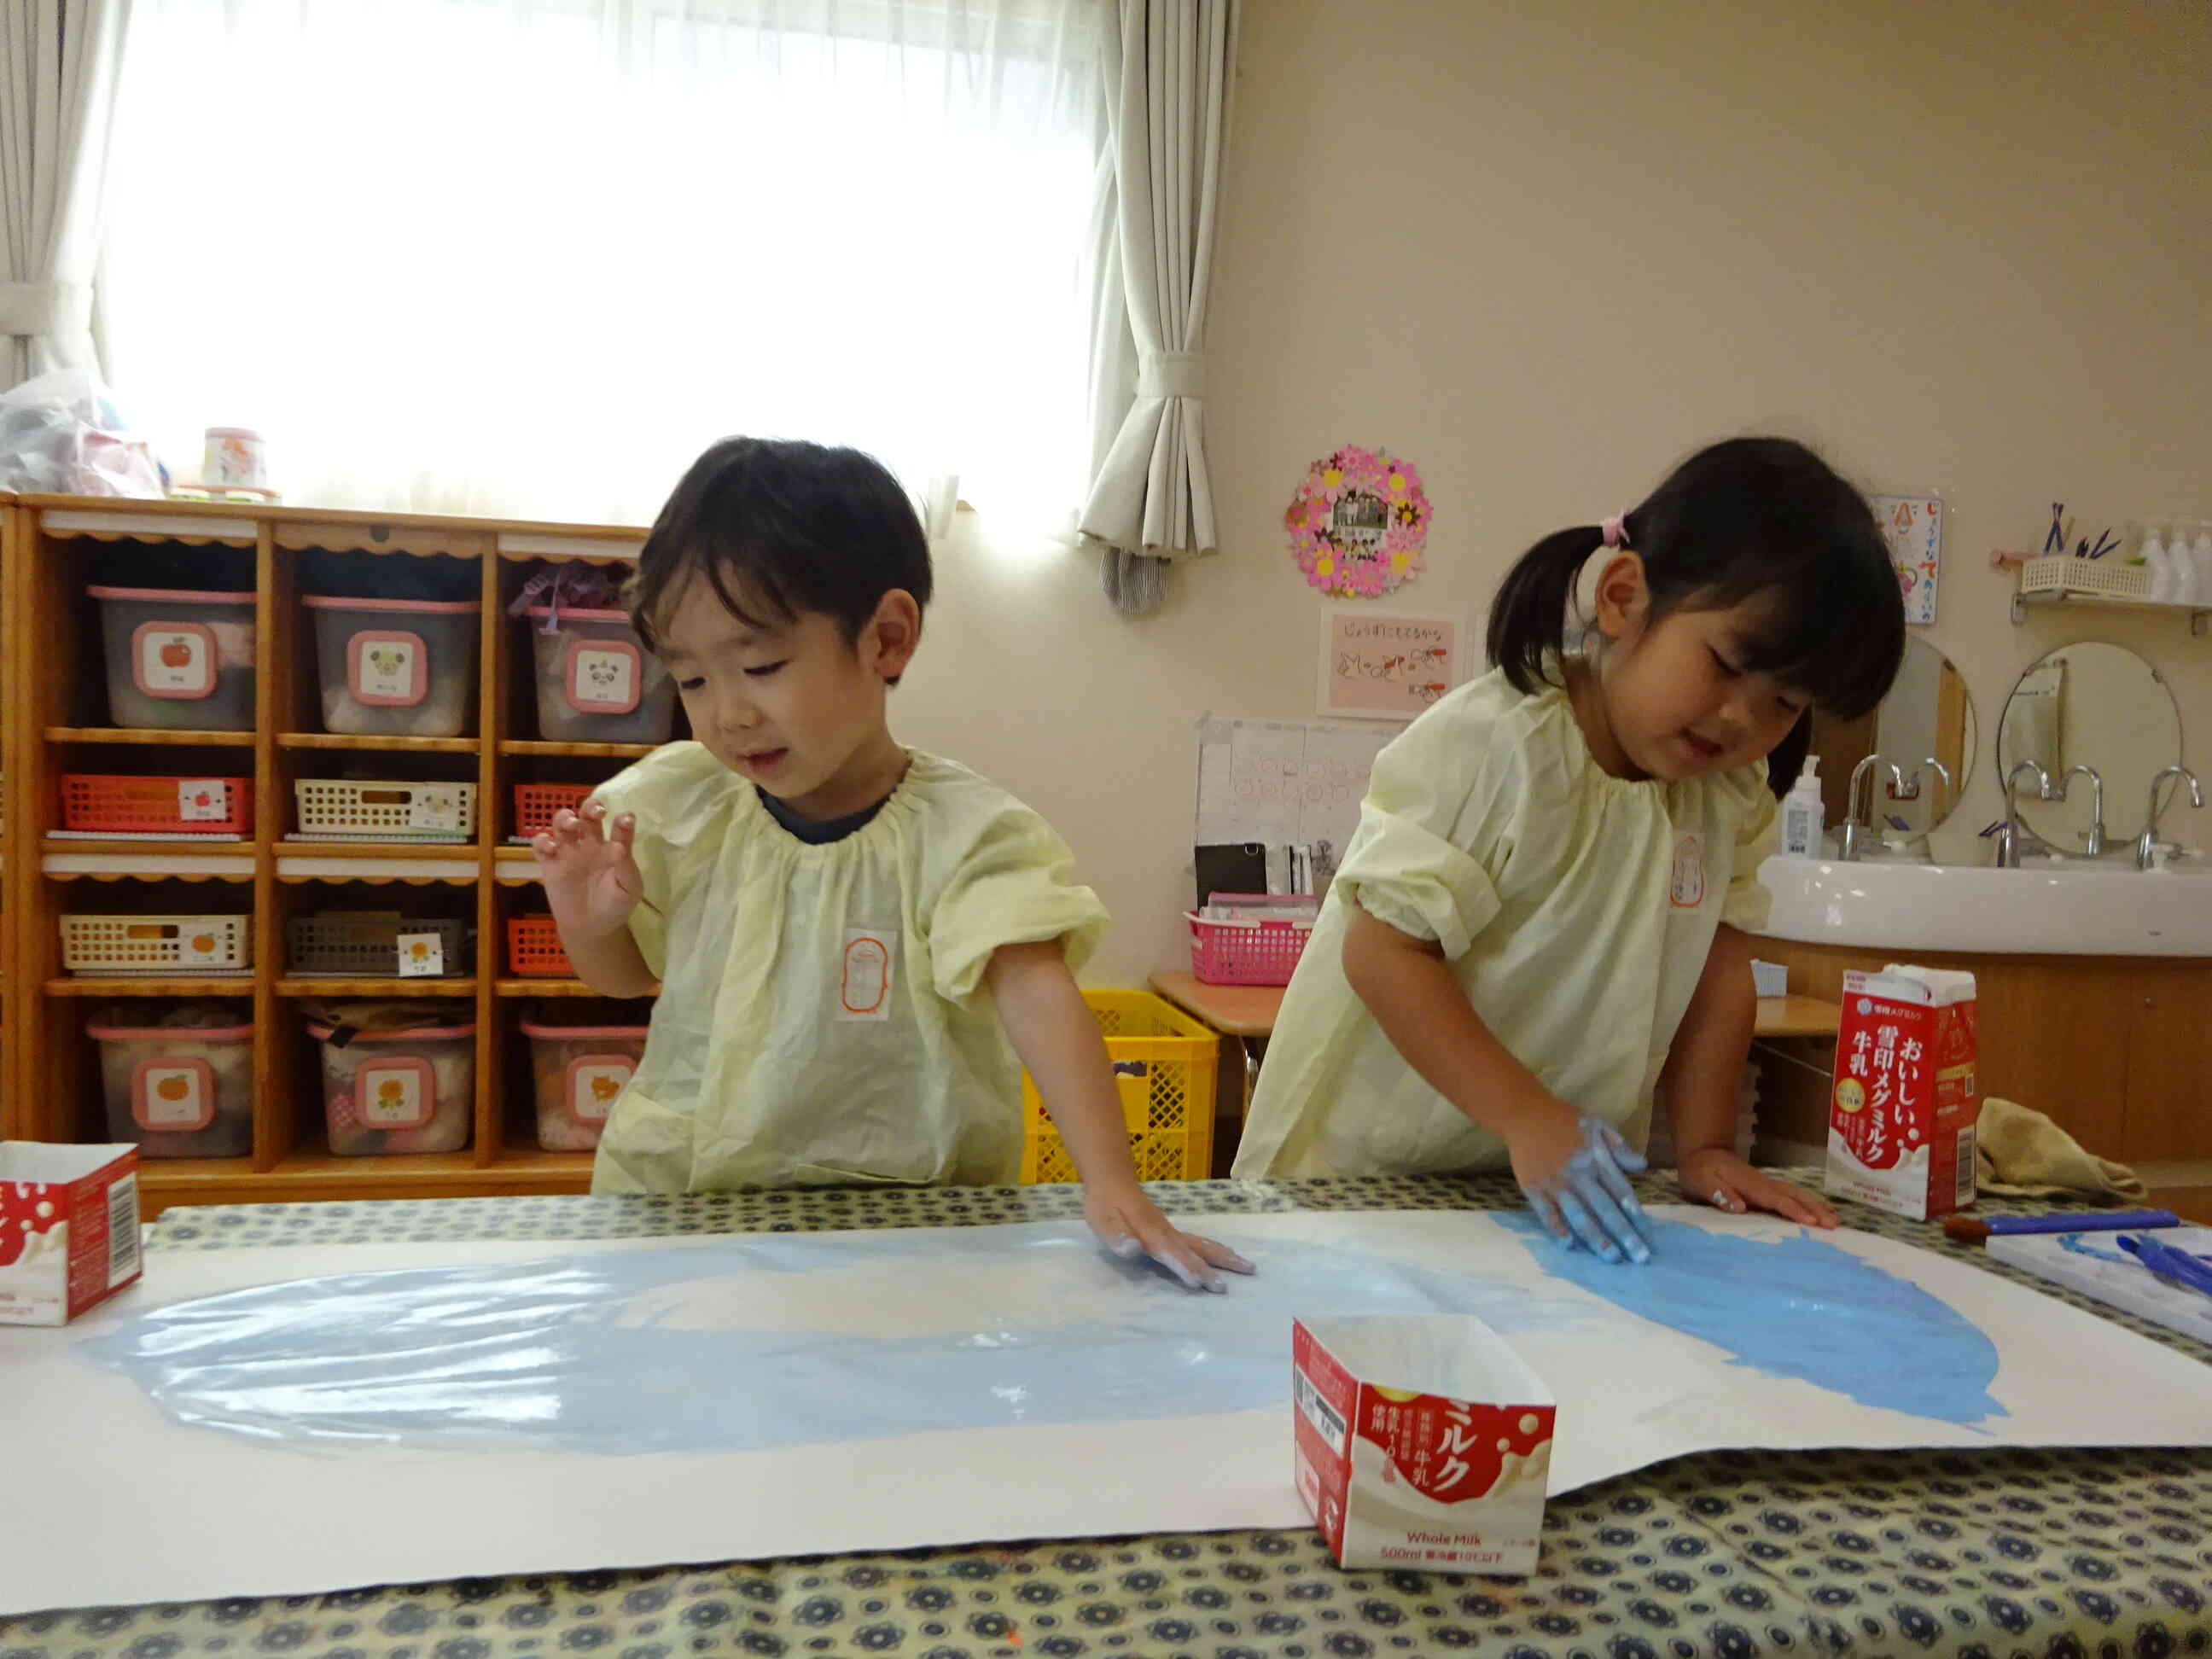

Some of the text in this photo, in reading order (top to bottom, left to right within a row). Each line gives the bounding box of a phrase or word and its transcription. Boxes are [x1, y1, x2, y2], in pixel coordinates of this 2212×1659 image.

[1849, 1030, 1871, 1077] 牛乳
[1870, 1025, 1899, 1162] 雪印メグミルク
[1895, 1037, 1923, 1126] おいしい
[1380, 1545, 1422, 1560] 500ml
[1406, 1531, 1482, 1546] Whole Milk
